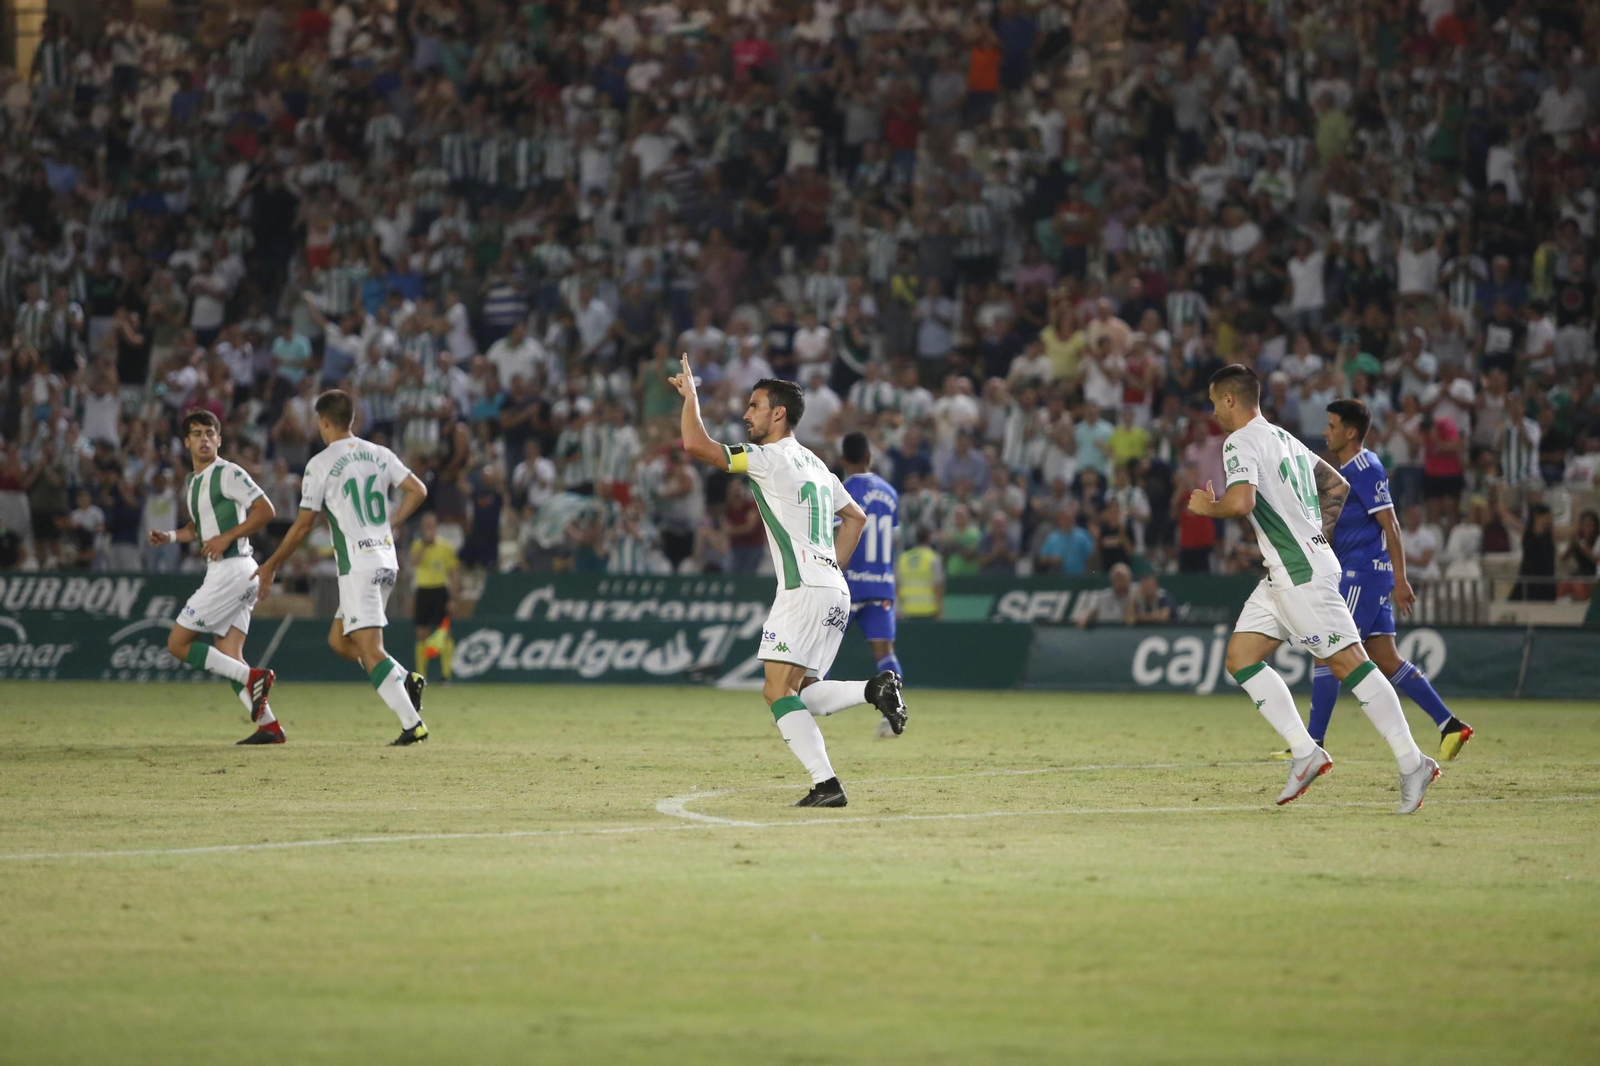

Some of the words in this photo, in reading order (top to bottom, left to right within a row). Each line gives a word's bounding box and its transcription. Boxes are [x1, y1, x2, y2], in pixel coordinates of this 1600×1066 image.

[342, 474, 387, 528] 16
[1278, 454, 1322, 520] 14
[798, 481, 834, 552] 10
[861, 513, 893, 565] 11
[496, 629, 650, 678] LaLiga
